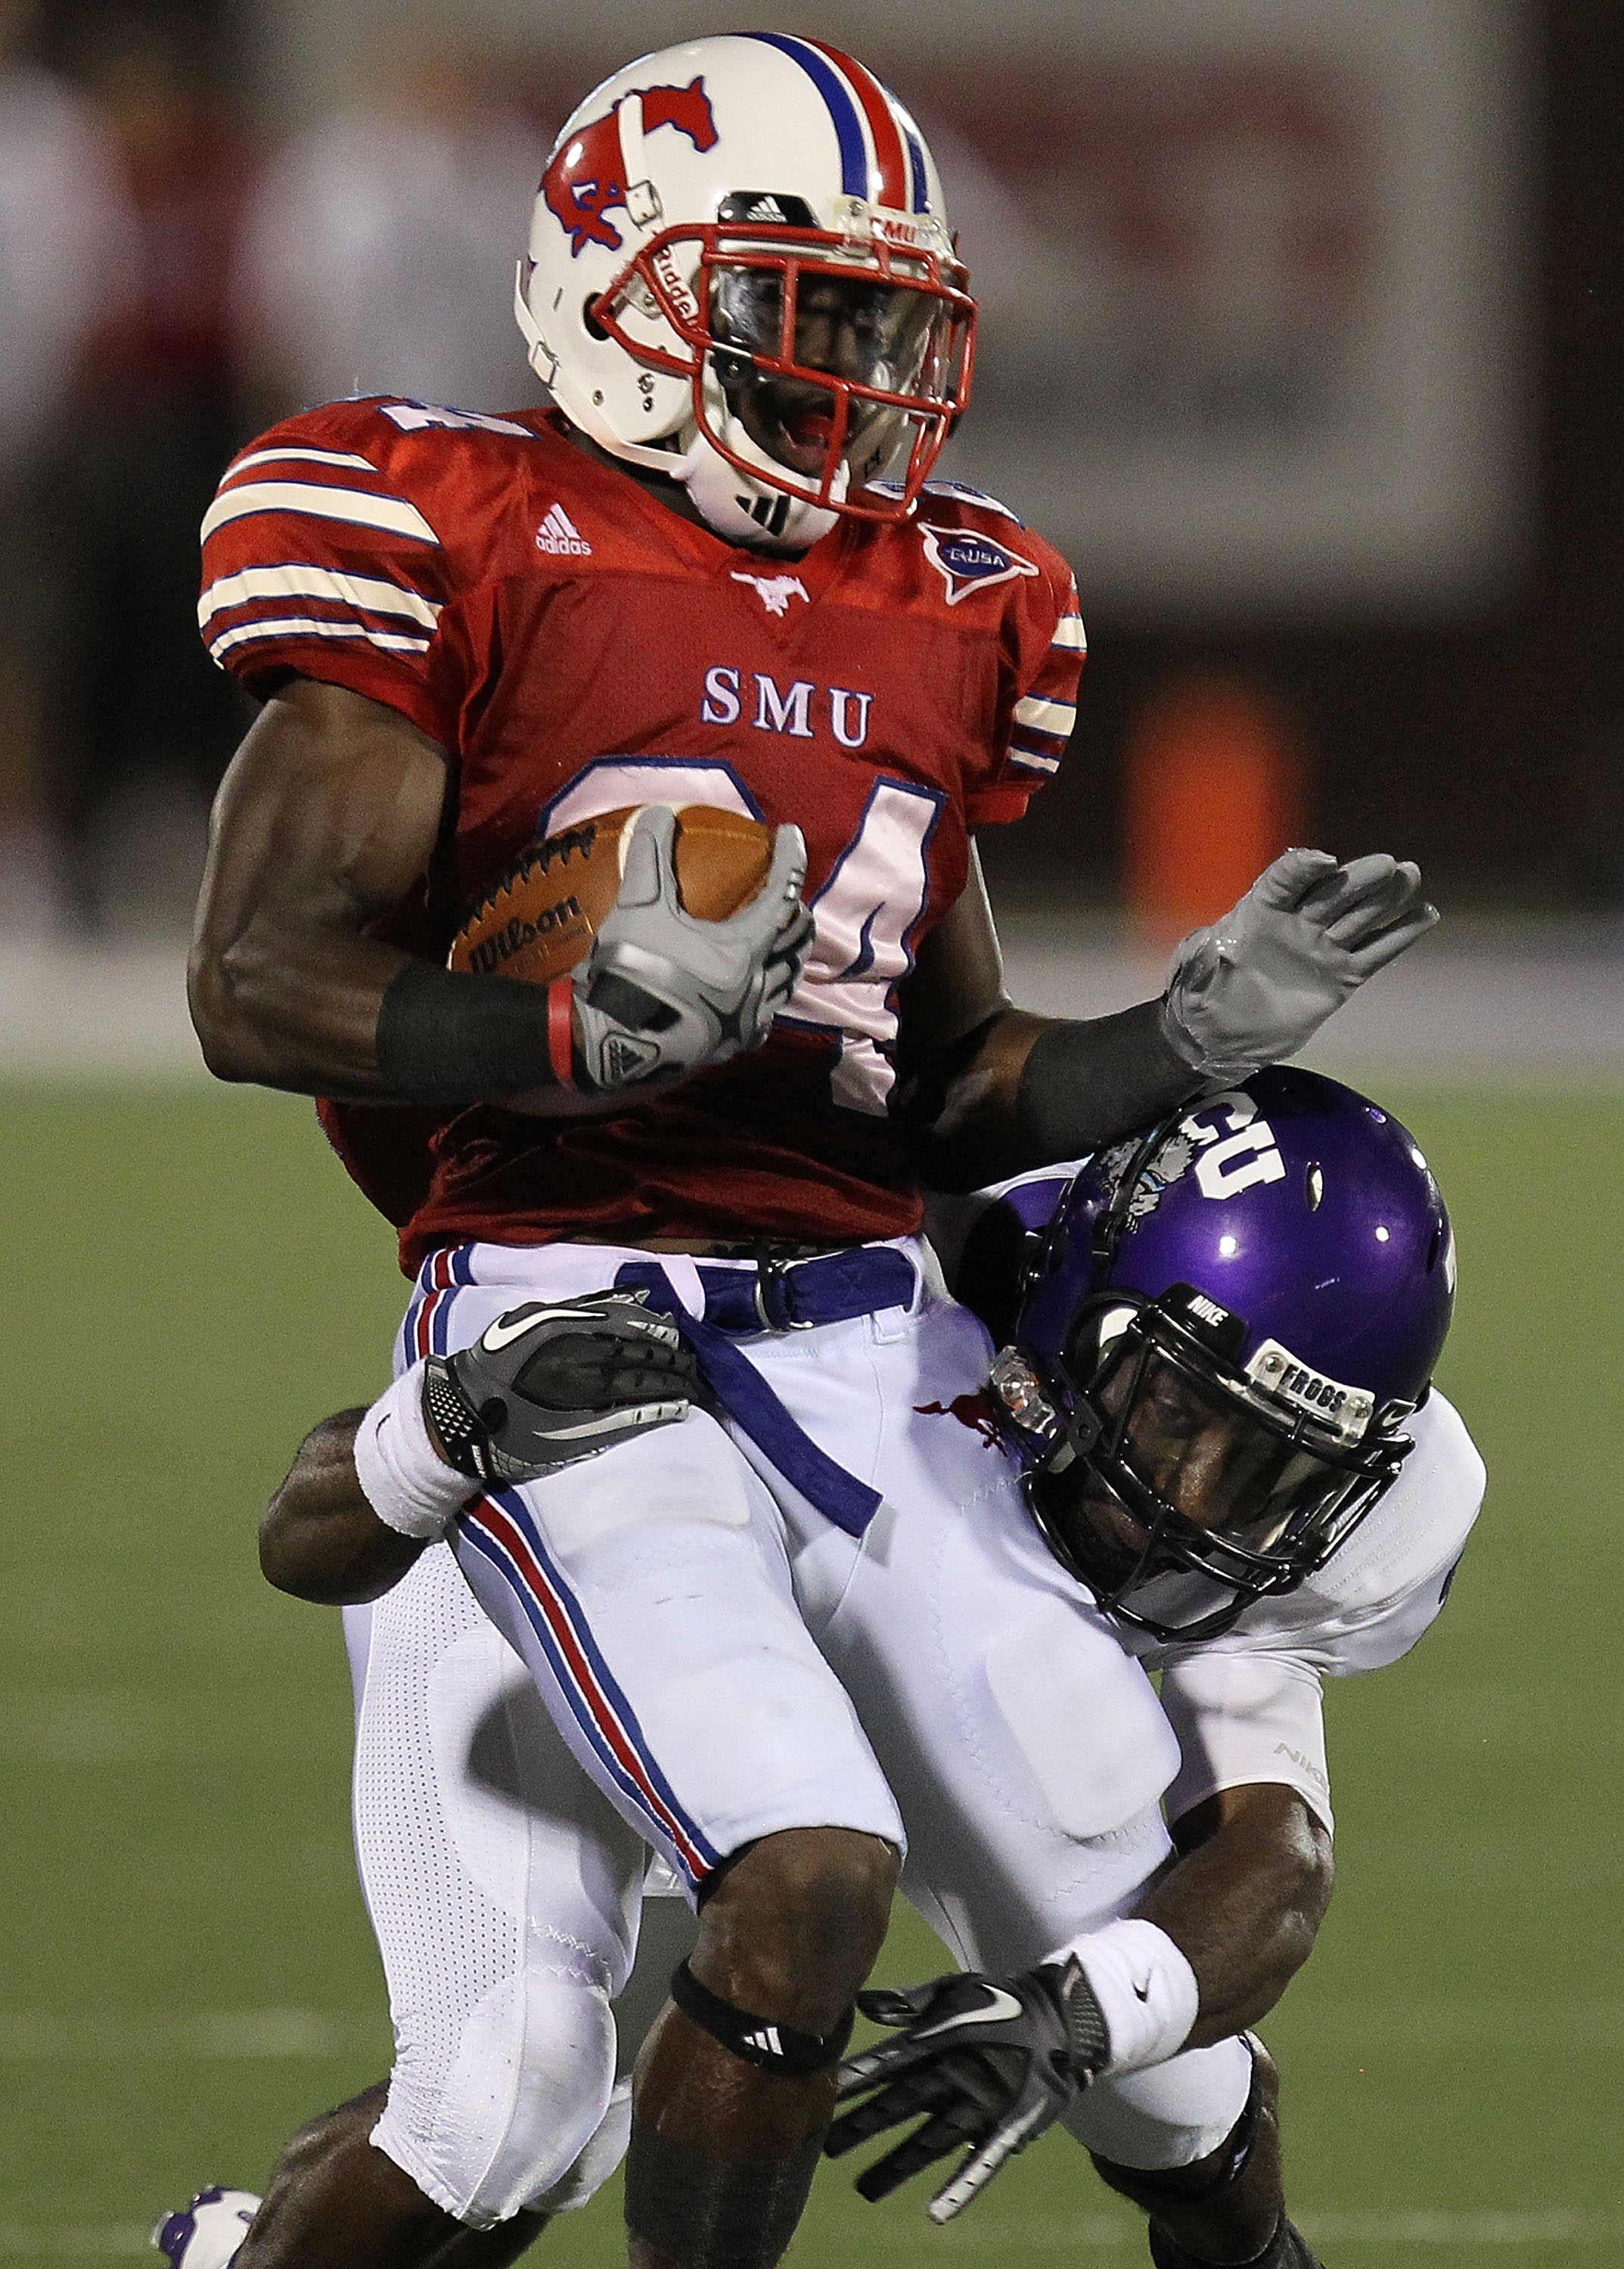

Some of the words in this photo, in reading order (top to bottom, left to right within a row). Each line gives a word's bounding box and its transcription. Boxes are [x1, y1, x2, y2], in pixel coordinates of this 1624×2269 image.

[535, 535, 593, 557] adidas
[701, 665, 873, 749] SMU
[468, 895, 582, 974] Wilson
[538, 755, 949, 1119] 4
[1187, 1294, 1229, 1327] NIKE
[1279, 1364, 1347, 1413] FROGS
